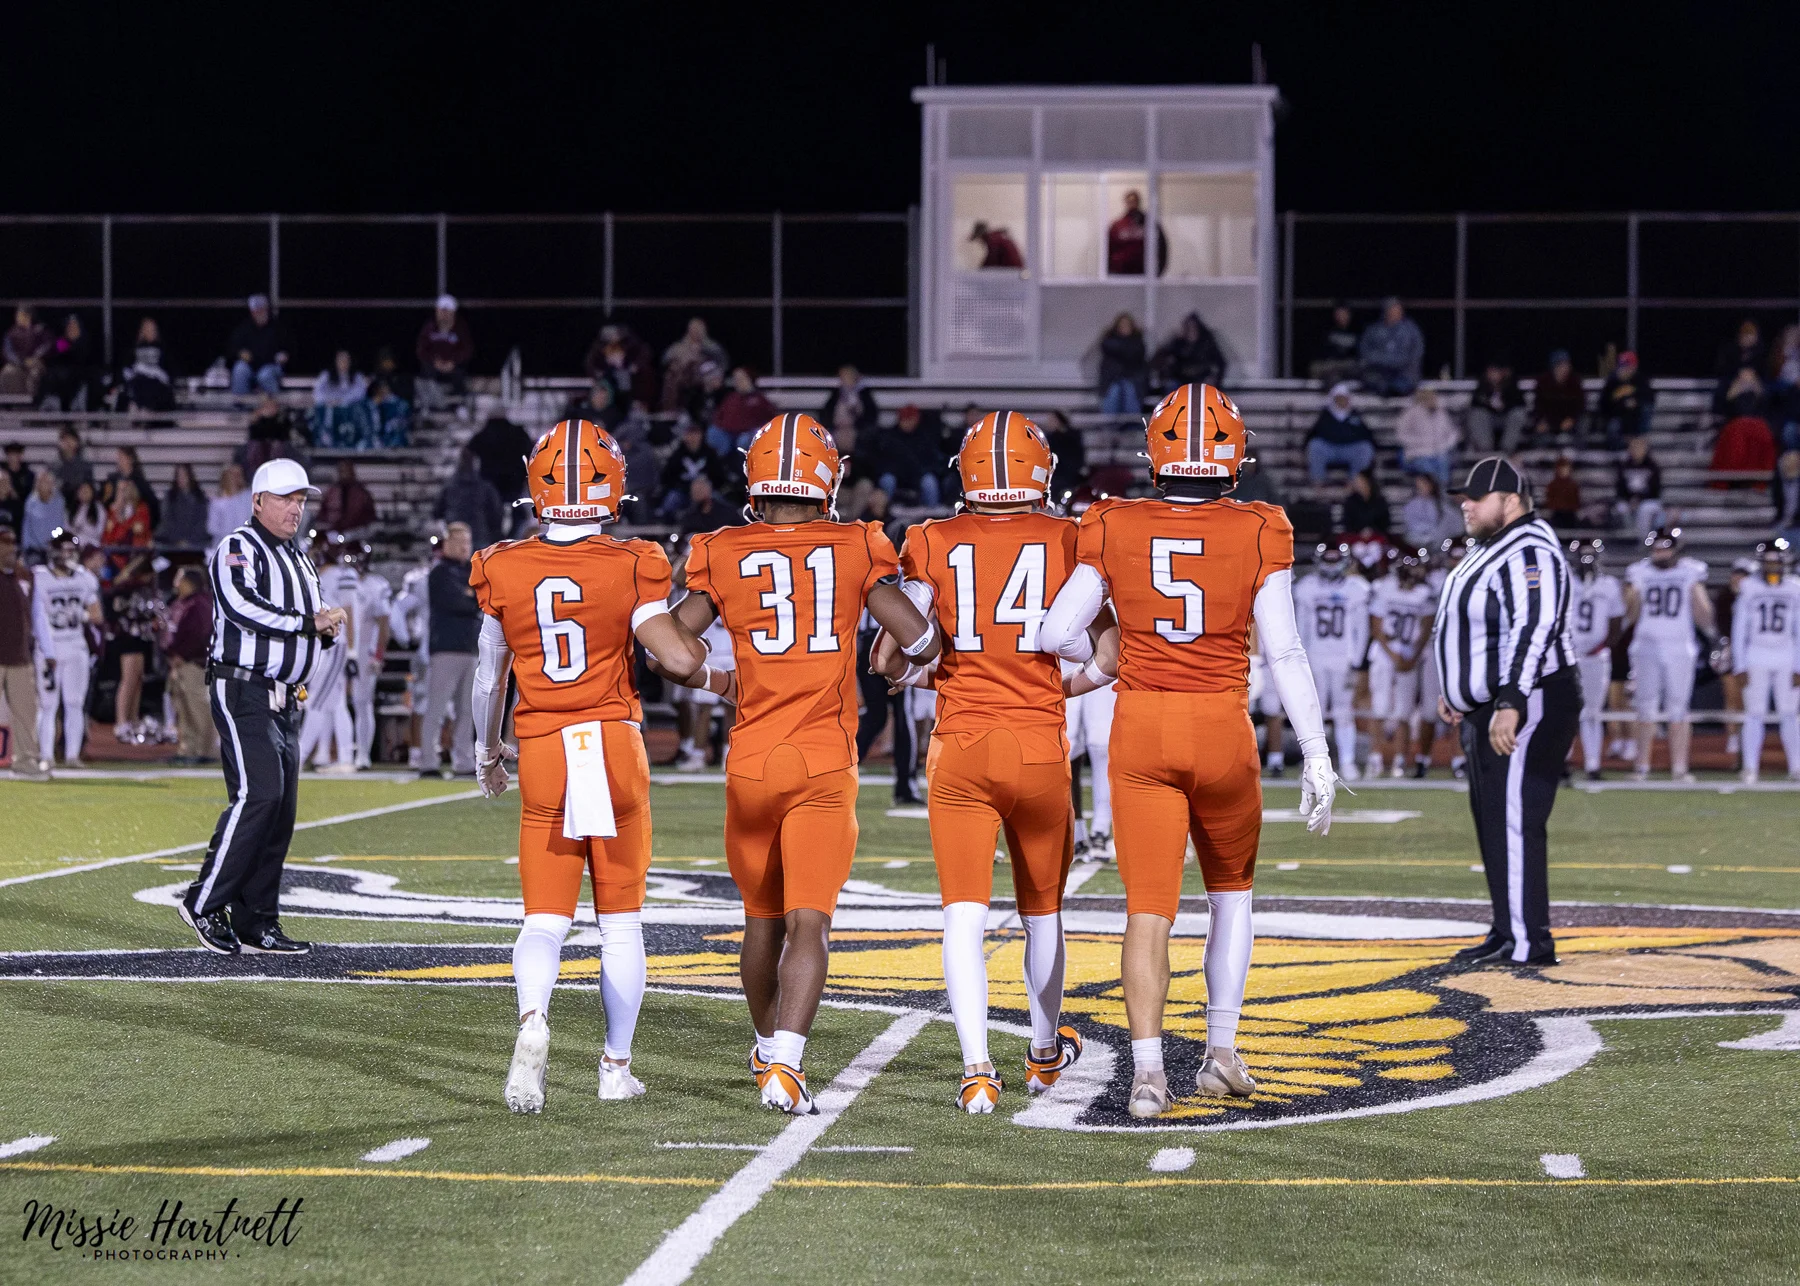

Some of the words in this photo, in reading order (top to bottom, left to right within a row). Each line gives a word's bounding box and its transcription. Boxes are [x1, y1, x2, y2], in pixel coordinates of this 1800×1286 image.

[1171, 464, 1218, 476] Riddell
[761, 483, 809, 495] Riddell
[978, 490, 1026, 501] Riddell
[552, 507, 598, 519] Riddell
[738, 544, 841, 656] 31
[947, 542, 1051, 653] 14
[1151, 537, 1205, 644] 5
[1645, 585, 1682, 618] 90
[533, 576, 588, 684] 6
[1758, 602, 1788, 633] 16
[572, 731, 593, 750] T
